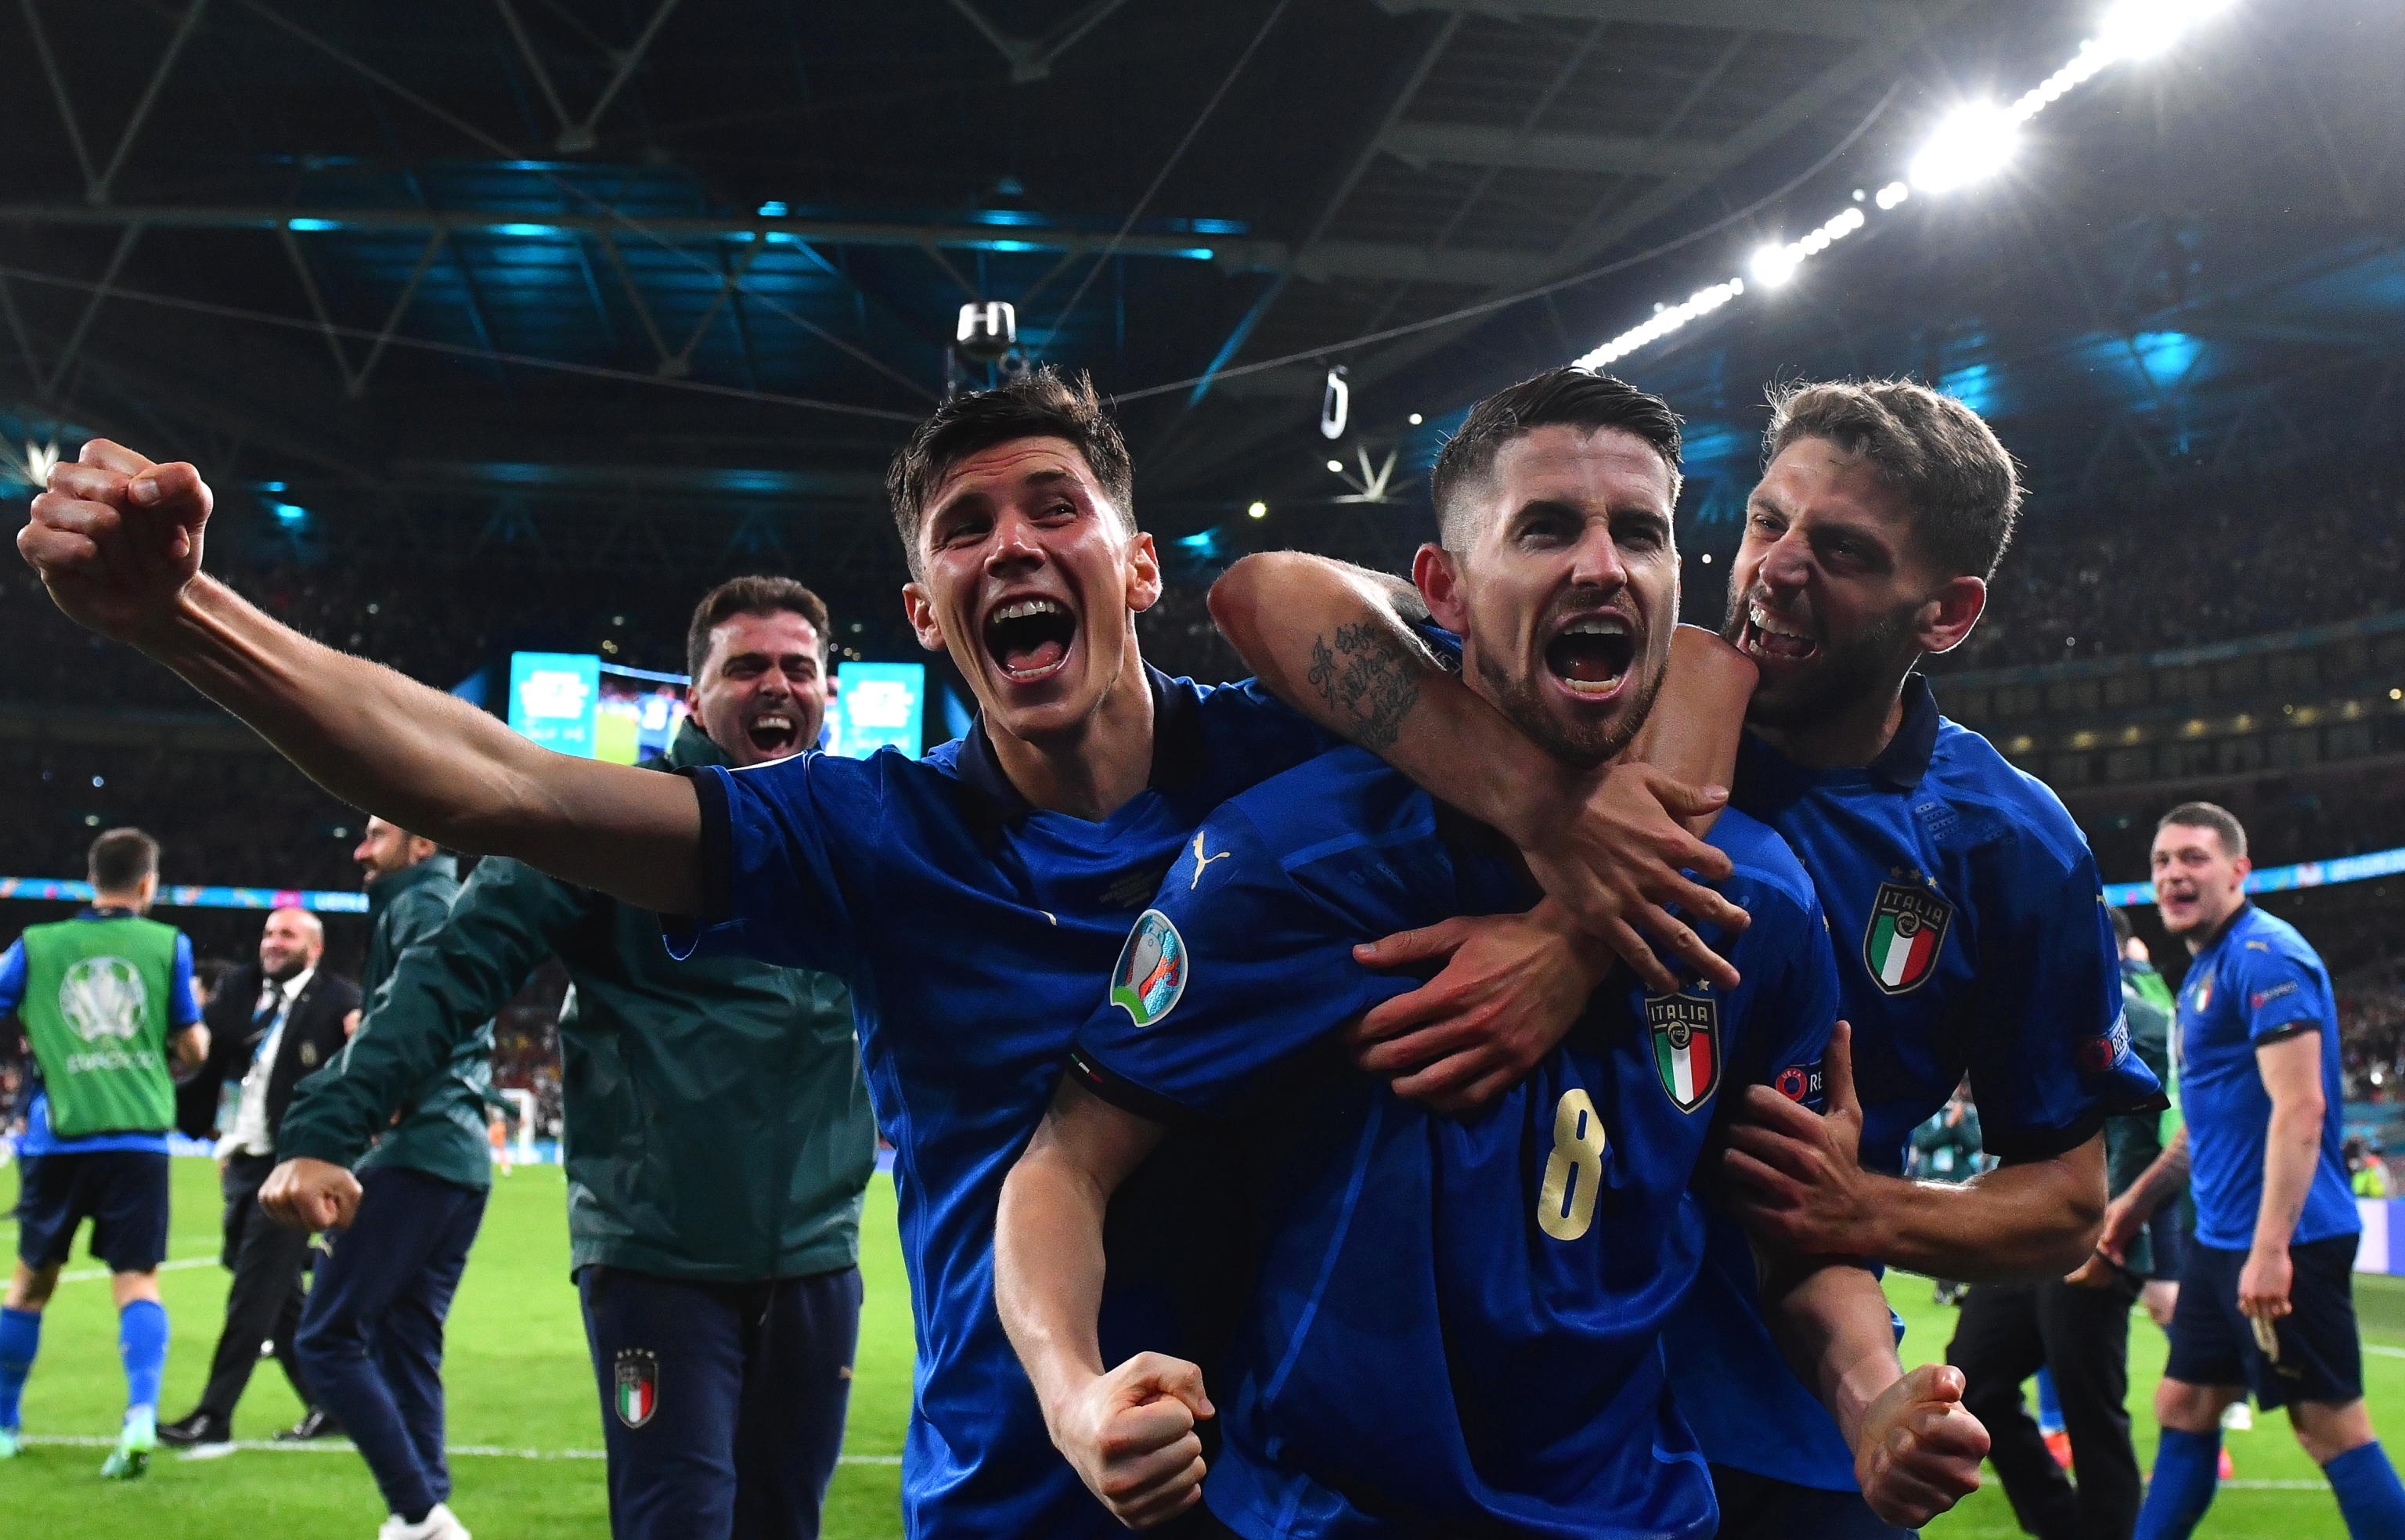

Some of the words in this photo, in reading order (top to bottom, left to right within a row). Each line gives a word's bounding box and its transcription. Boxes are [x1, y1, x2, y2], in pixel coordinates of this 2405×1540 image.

[1883, 890, 1943, 924] ITALIA
[1650, 1004, 1708, 1022] ITALIA
[1781, 1069, 1801, 1080] UEFA
[1537, 1087, 1606, 1242] 8
